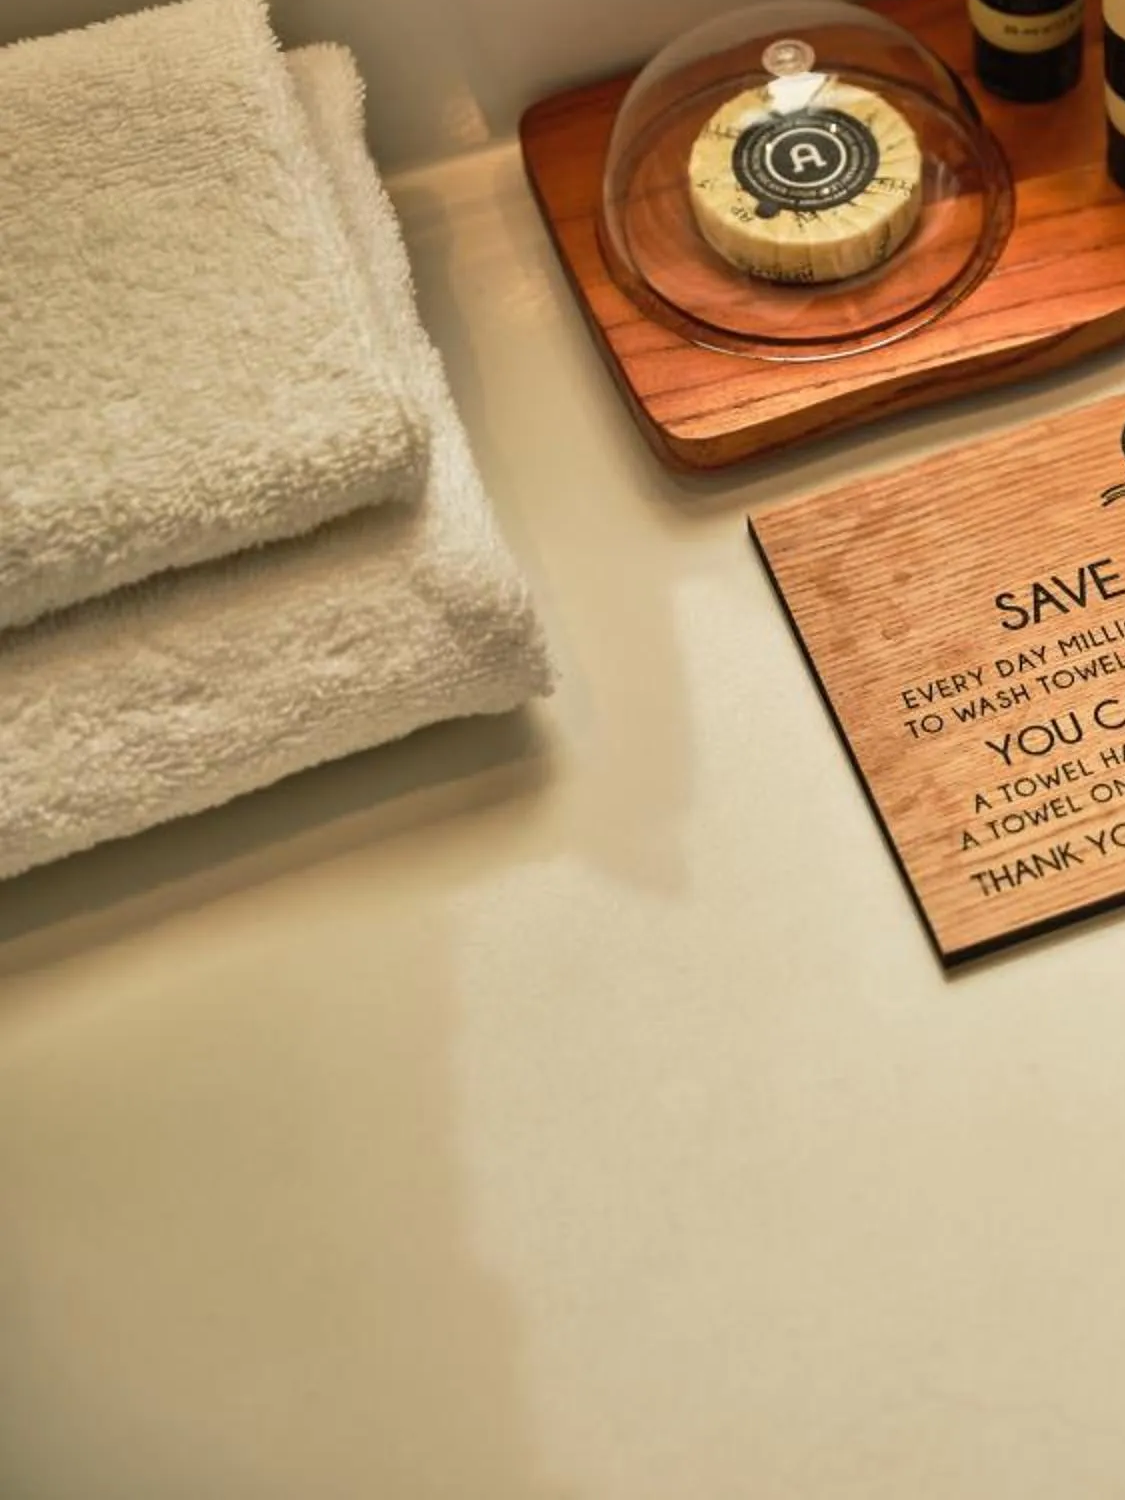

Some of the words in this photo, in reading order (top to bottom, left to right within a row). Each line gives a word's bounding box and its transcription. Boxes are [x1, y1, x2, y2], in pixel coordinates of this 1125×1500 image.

[902, 667, 985, 710] EVERY
[994, 645, 1047, 679] DAY
[903, 713, 944, 739] TO
[951, 683, 1031, 723] WASH
[984, 711, 1083, 767] YOU
[974, 793, 993, 815] A
[997, 759, 1094, 803] TOWEL
[960, 830, 980, 852] A
[985, 795, 1083, 841] TOWEL
[970, 841, 1084, 897] THANK
